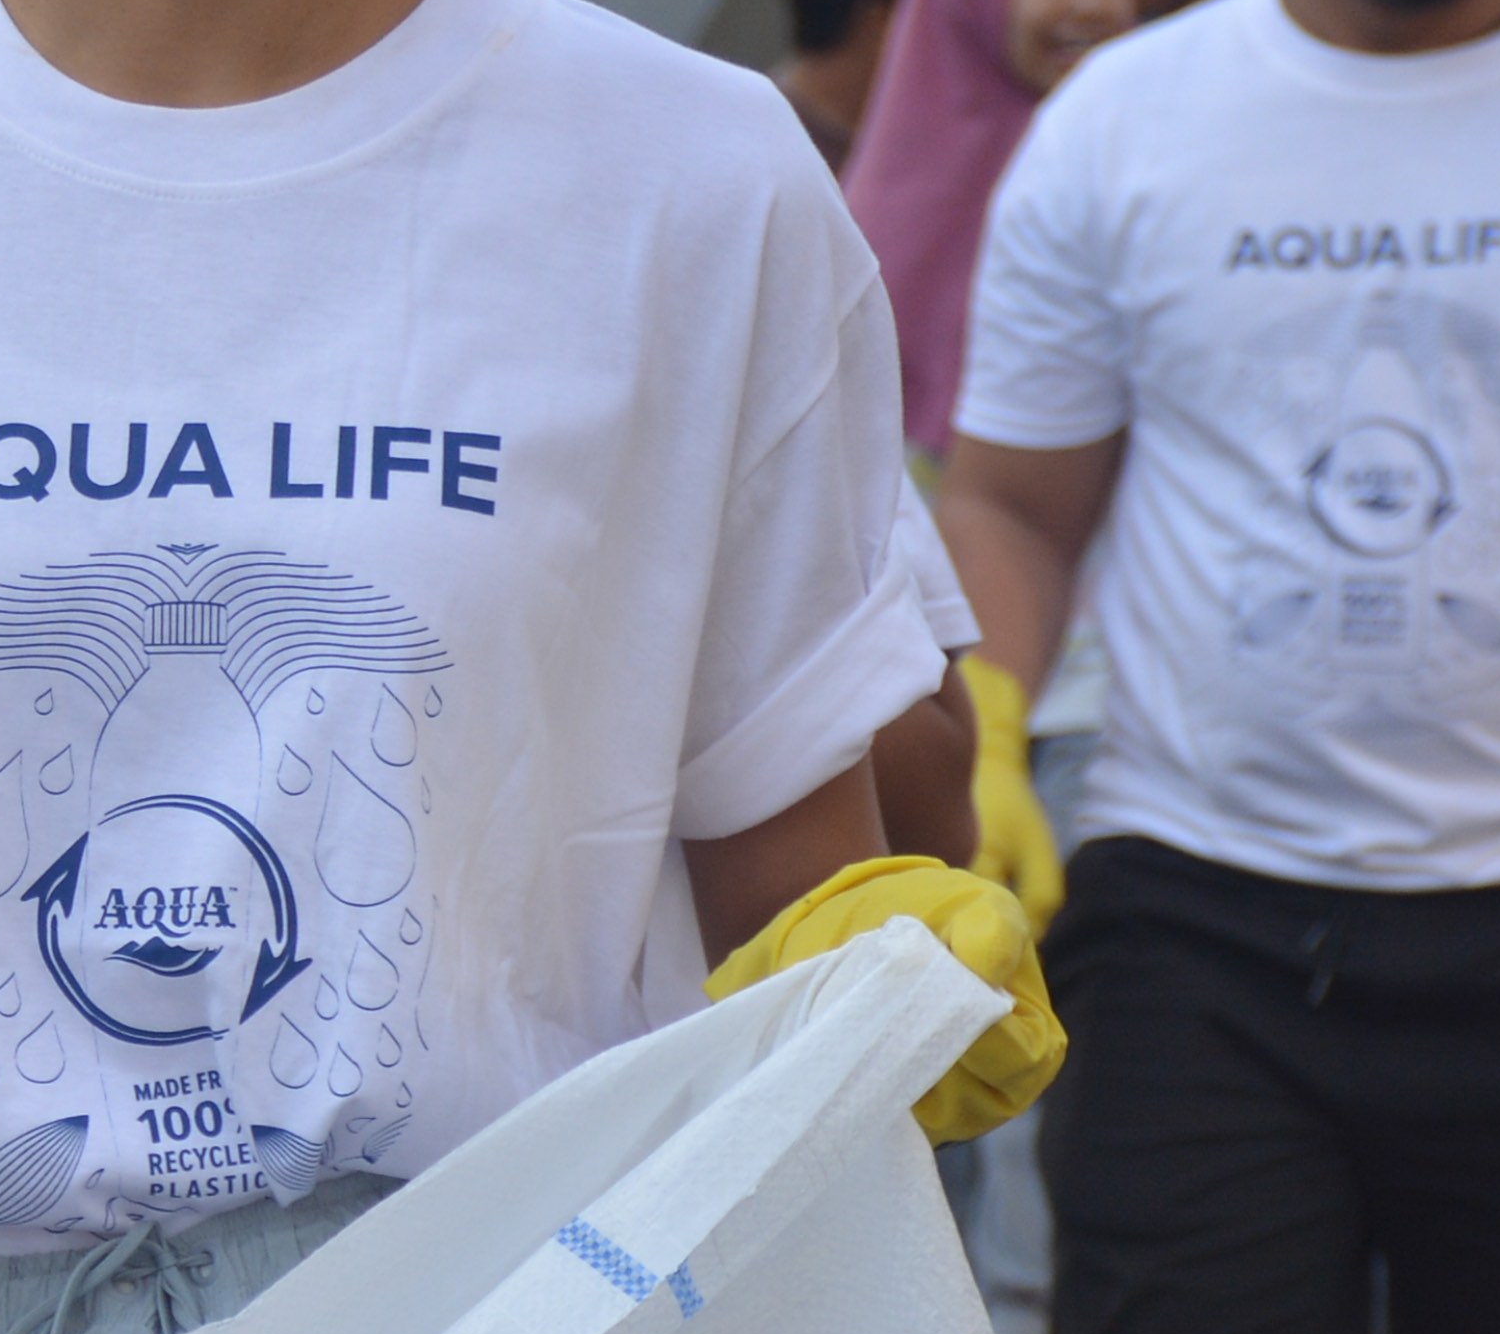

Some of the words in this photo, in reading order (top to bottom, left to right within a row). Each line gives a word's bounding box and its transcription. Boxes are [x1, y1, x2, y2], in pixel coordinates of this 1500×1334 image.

[1224, 224, 1406, 274] AQUA
[270, 421, 502, 517] LIFE
[93, 885, 237, 939] AQUA
[133, 1075, 193, 1102] MADE
[196, 1069, 223, 1092] FR
[147, 1142, 258, 1176] RECYCLE
[149, 1170, 270, 1199] PLASTIC
